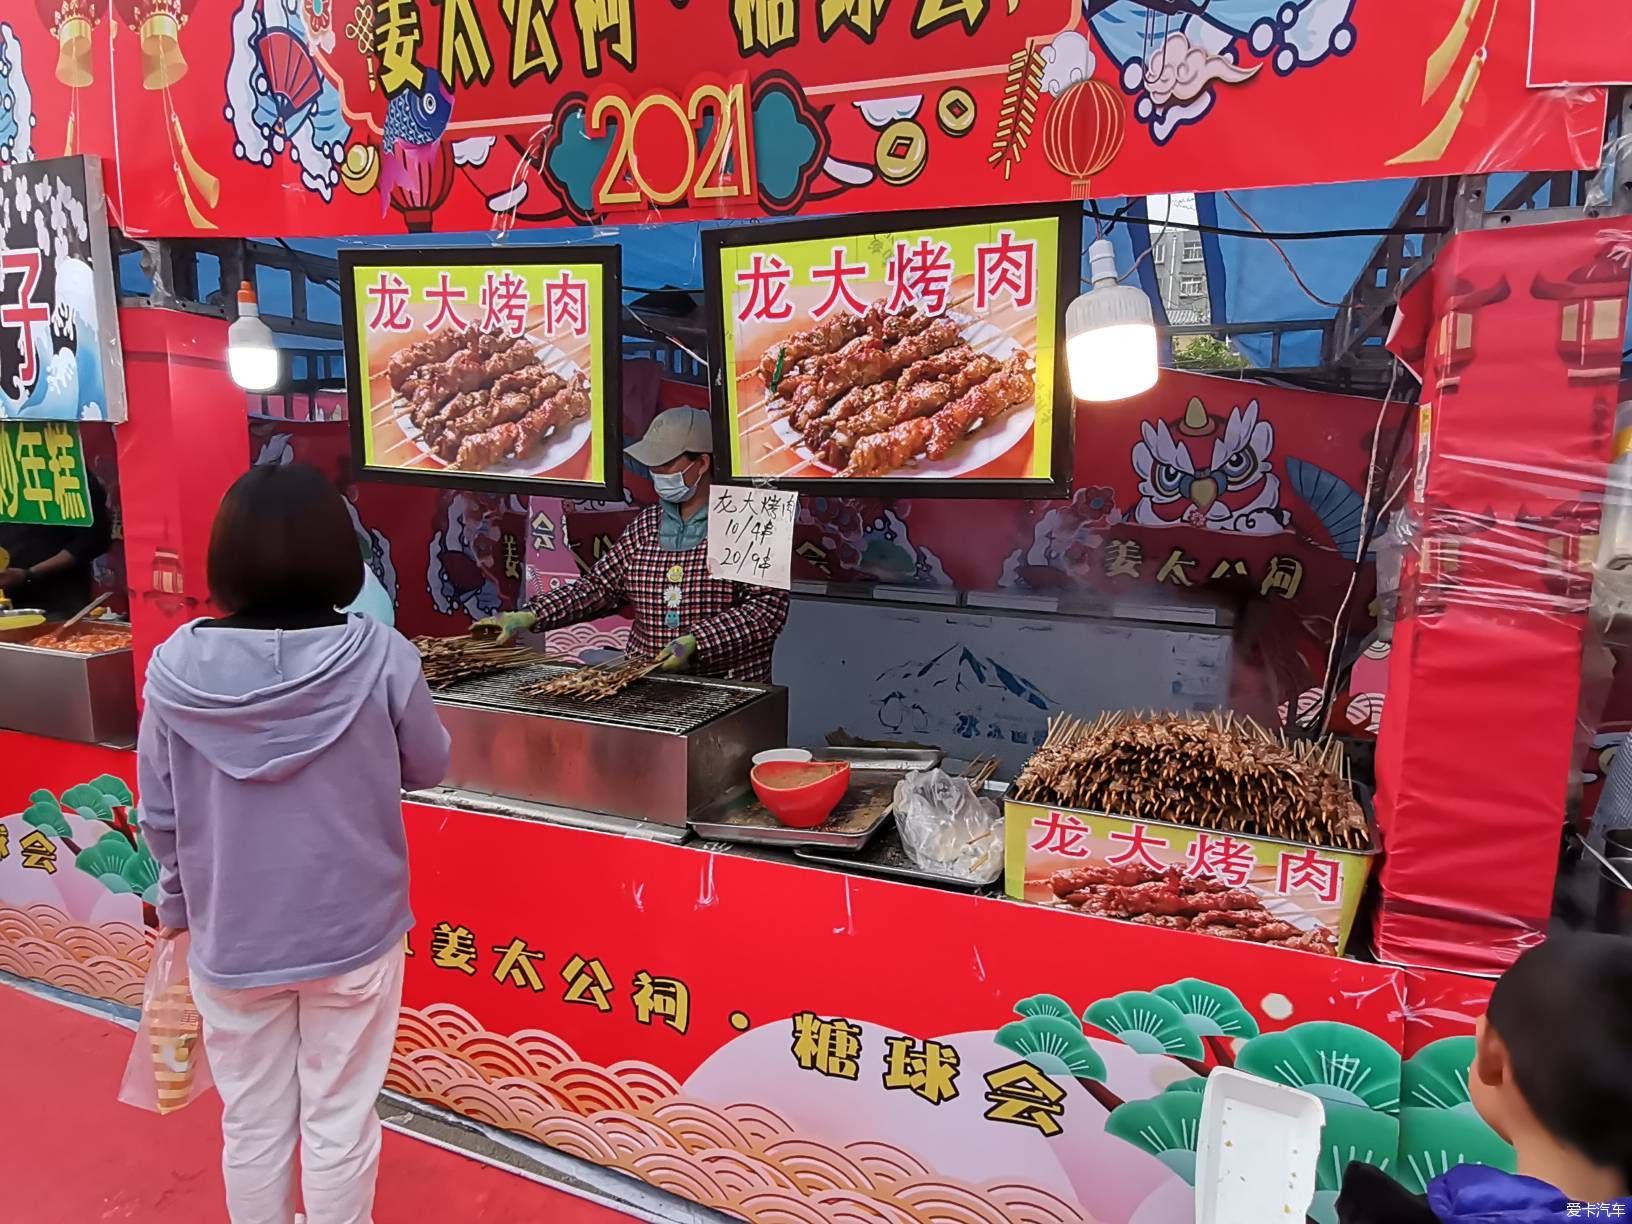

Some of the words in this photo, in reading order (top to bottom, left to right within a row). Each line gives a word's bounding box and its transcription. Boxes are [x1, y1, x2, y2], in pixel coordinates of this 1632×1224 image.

[590, 82, 753, 205] 2021
[367, 269, 589, 338] 龙大烤肉
[735, 229, 1038, 323] 龙大烤肉
[1031, 811, 1342, 902] 龙大烤肉
